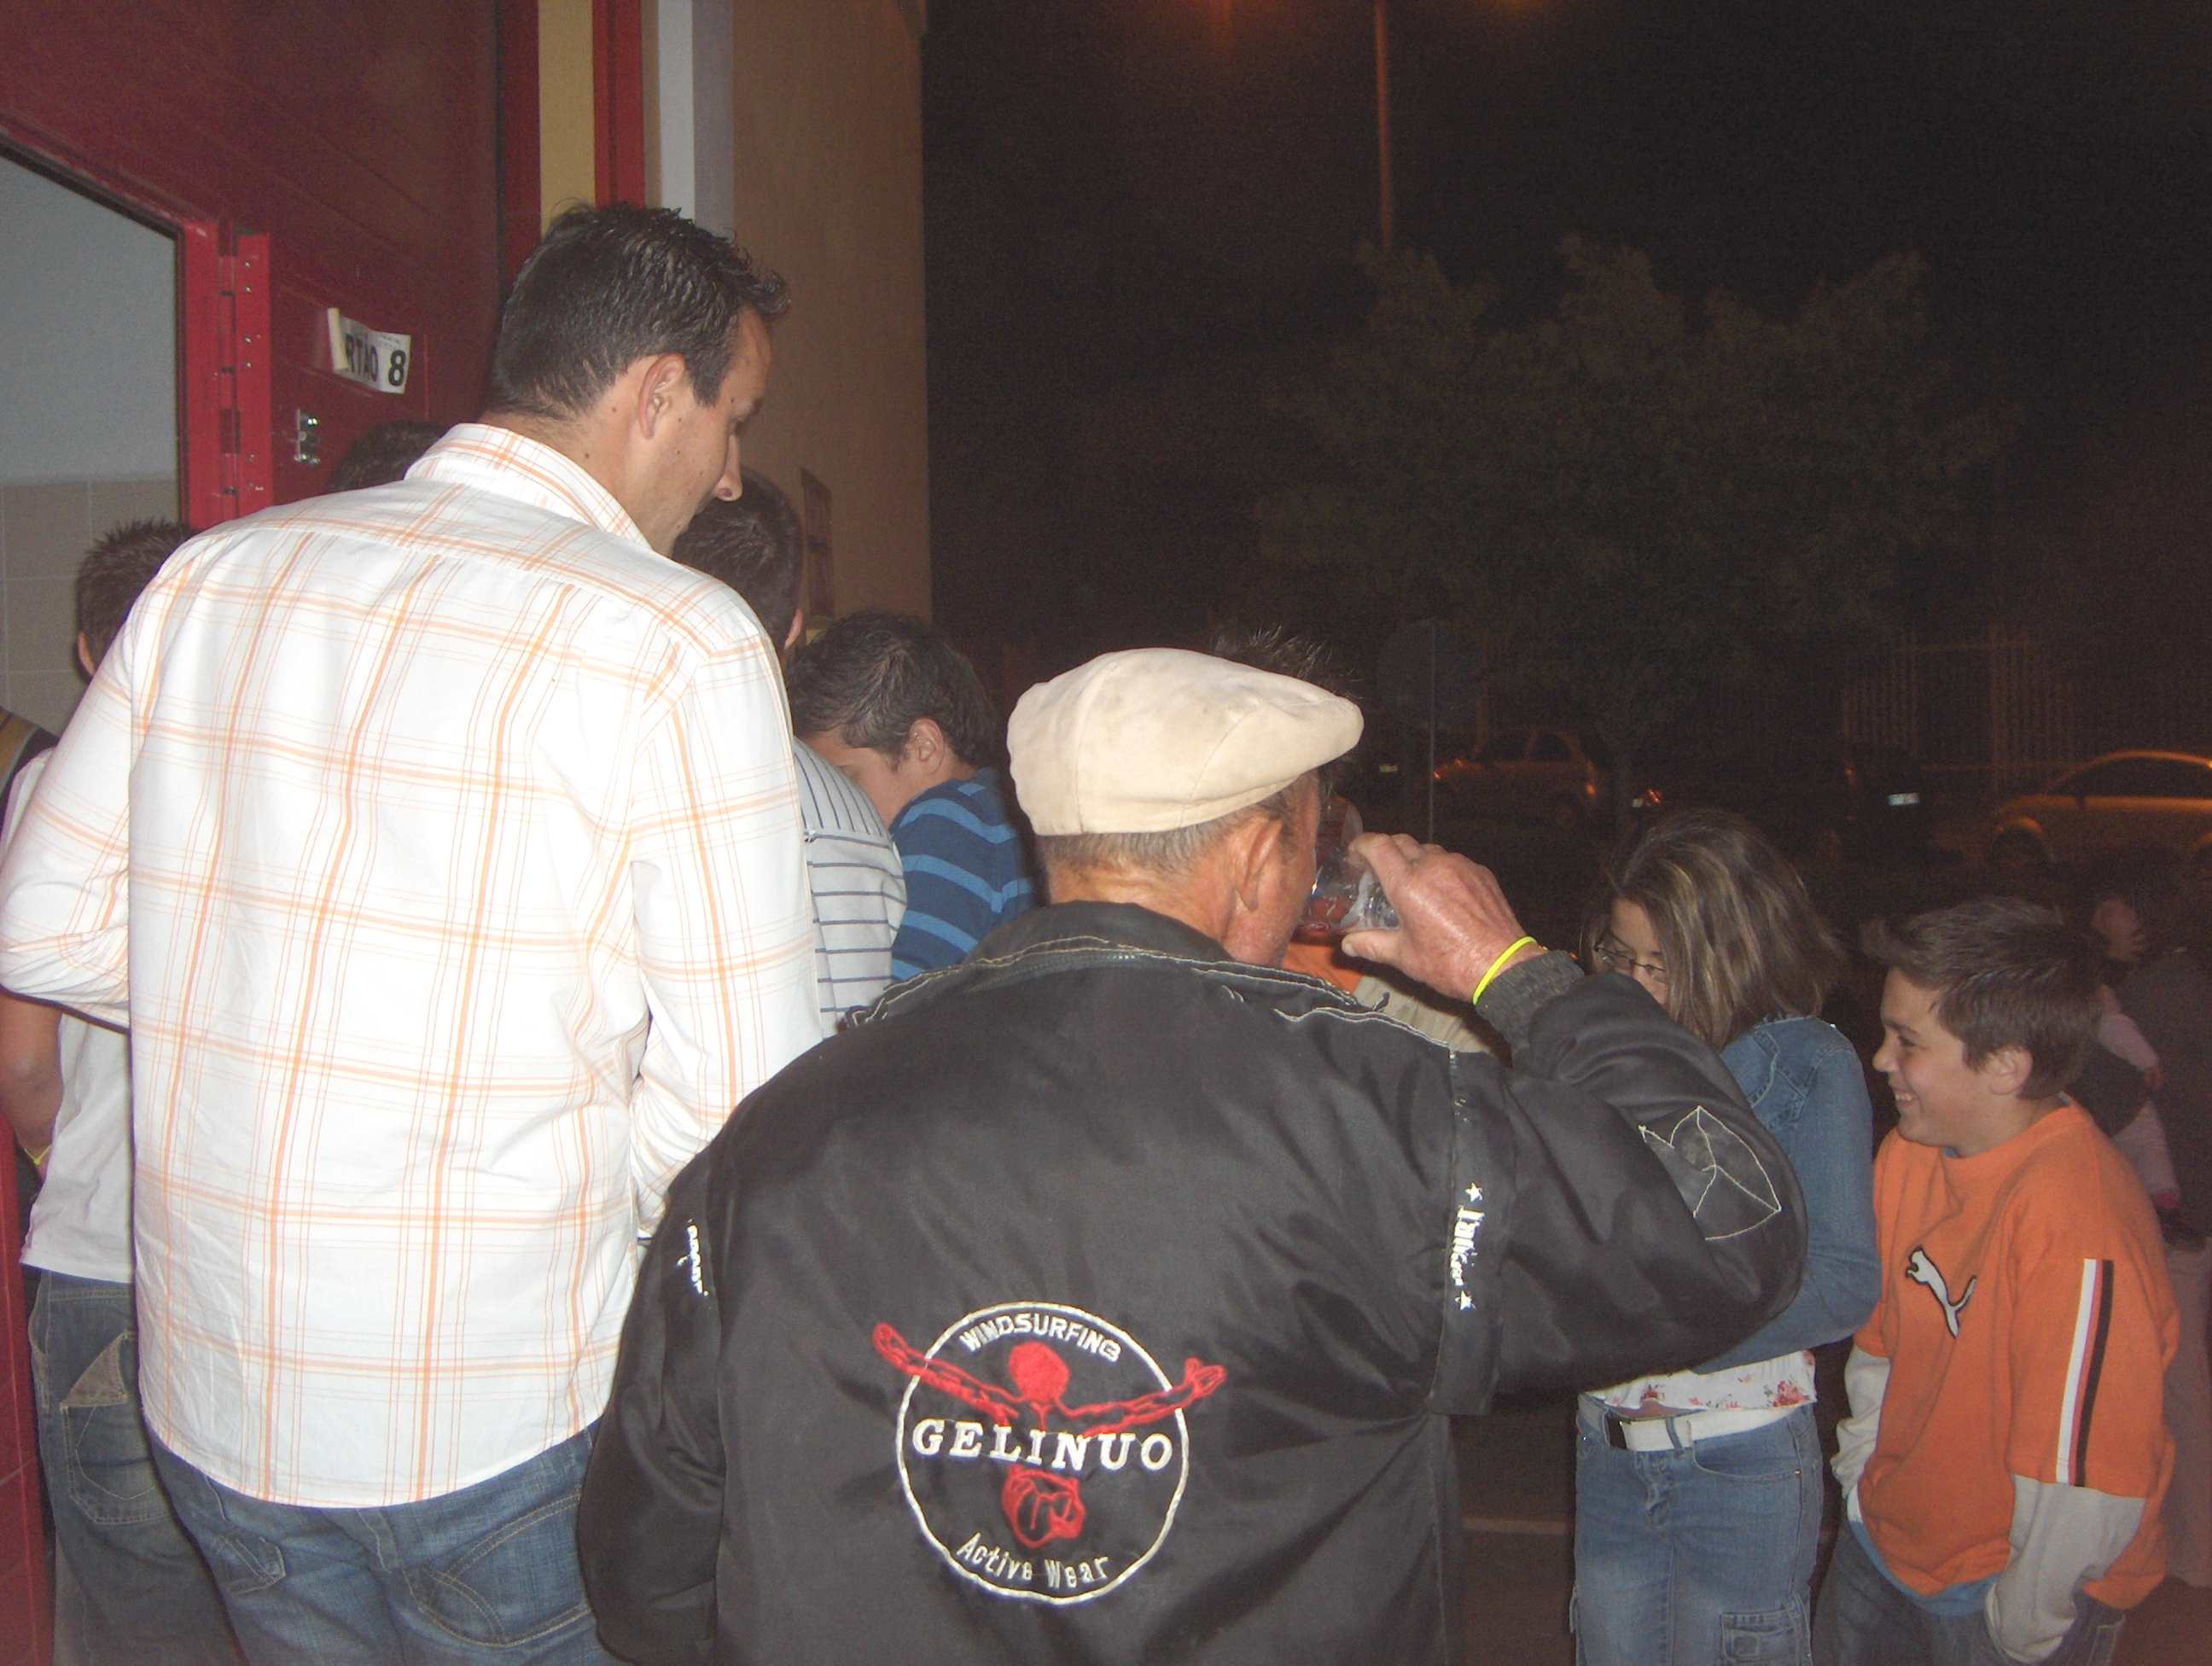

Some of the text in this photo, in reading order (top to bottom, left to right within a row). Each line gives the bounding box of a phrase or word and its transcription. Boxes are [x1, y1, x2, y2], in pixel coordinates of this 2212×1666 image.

[387, 349, 406, 387] 8
[958, 1313, 1121, 1362] WINDSURFING
[911, 1418, 1173, 1471] GELINUO
[956, 1532, 1109, 1589] Active Wear
